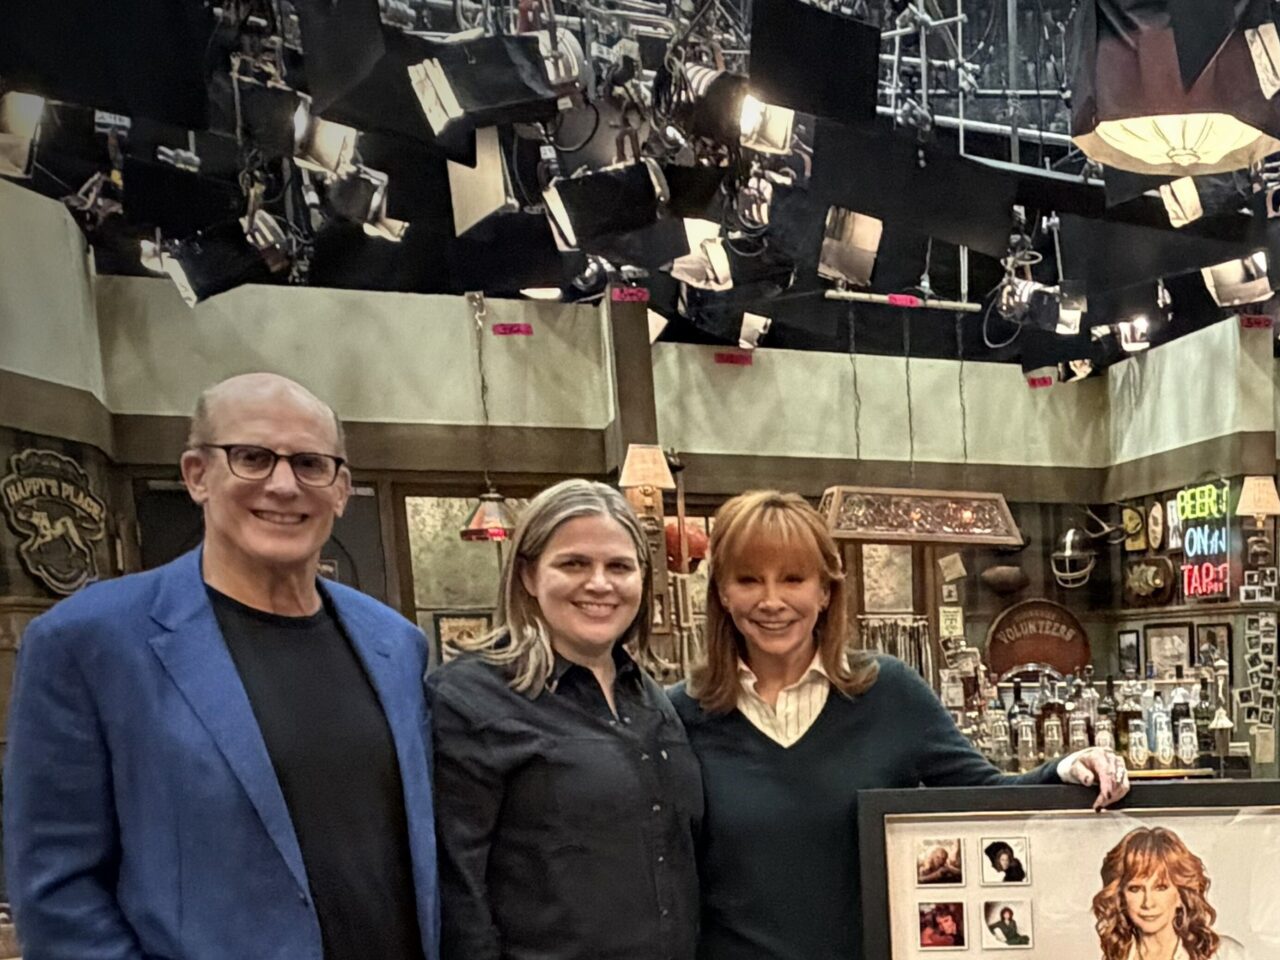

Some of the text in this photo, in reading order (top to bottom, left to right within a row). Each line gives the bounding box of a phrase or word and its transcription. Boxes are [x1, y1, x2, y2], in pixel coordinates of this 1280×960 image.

[1177, 484, 1219, 520] BEER
[1184, 525, 1209, 557] ON
[1181, 562, 1214, 596] TAP
[998, 620, 1076, 644] VOLUNTEERS
